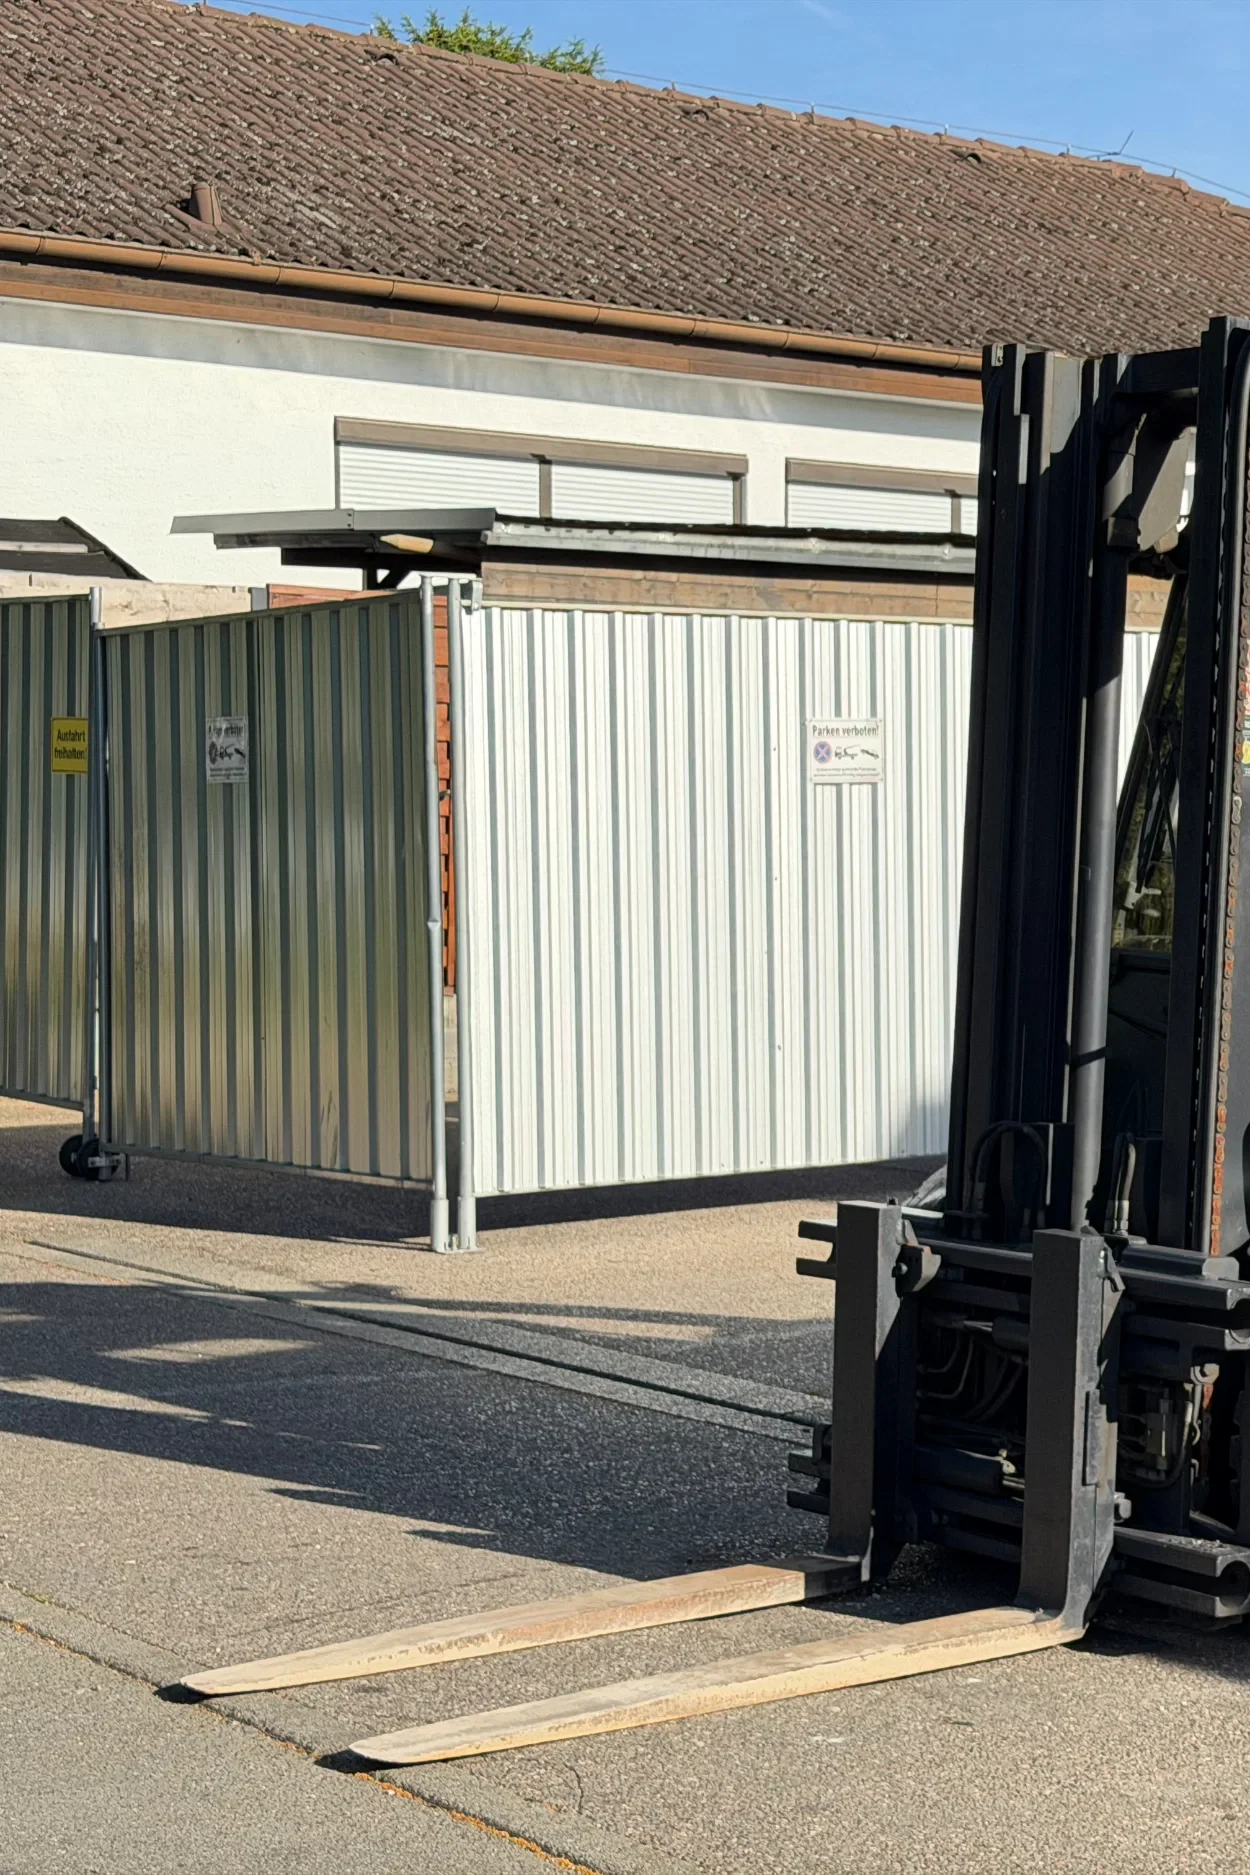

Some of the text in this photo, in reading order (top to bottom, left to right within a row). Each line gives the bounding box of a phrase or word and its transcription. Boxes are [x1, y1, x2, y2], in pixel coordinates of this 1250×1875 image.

[56, 729, 86, 742] Ausfahrt
[812, 724, 879, 738] Parken verboten!
